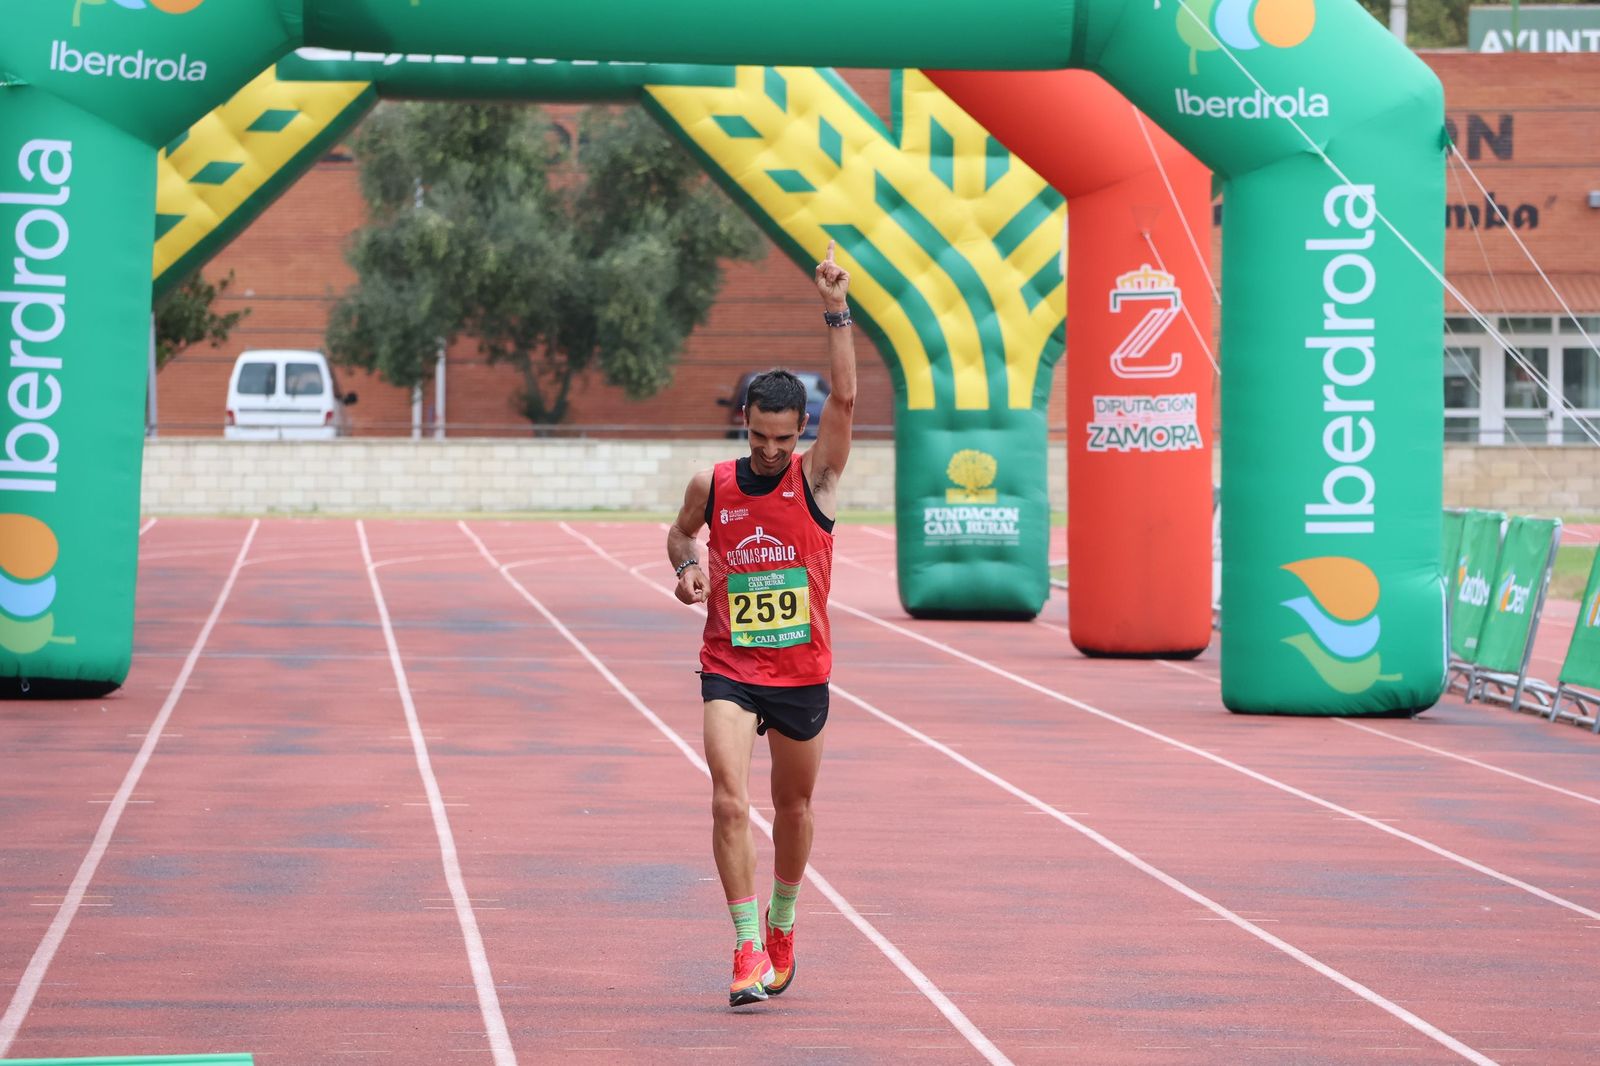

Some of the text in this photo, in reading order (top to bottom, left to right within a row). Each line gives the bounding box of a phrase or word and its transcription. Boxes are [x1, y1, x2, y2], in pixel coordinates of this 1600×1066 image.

[50, 40, 207, 82] Iberdrola
[1175, 87, 1330, 119] Iberdrola
[0, 138, 72, 493] Iberdrola
[1305, 183, 1376, 535] Iberdrola
[1088, 423, 1202, 449] ZAMORA
[924, 521, 1020, 535] CAJA RURAL
[726, 545, 797, 567] CECINAS PABLO
[765, 579, 786, 587] RURAL
[734, 591, 797, 624] 259
[755, 630, 807, 643] CAJA RURAL
